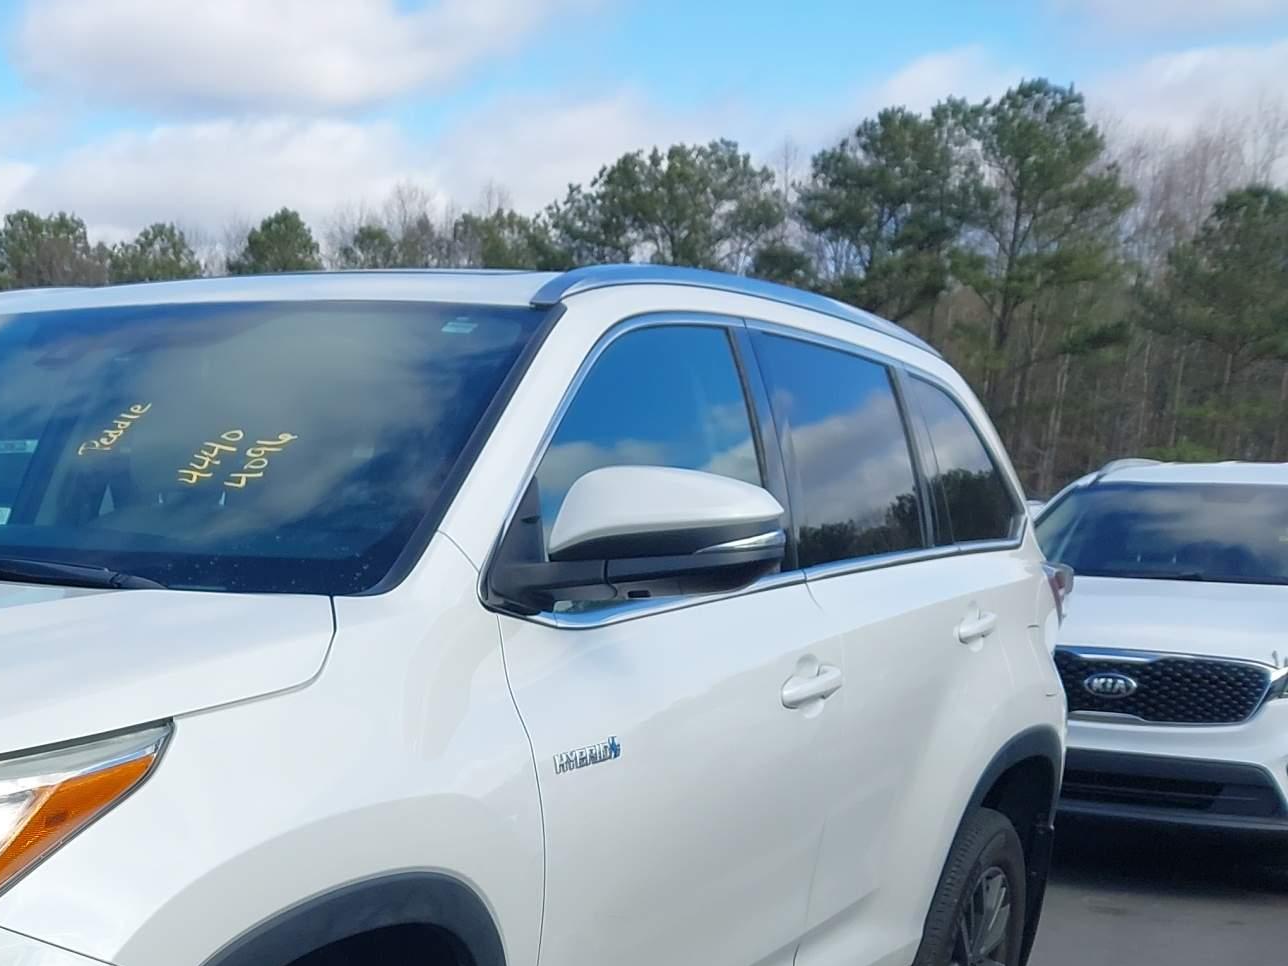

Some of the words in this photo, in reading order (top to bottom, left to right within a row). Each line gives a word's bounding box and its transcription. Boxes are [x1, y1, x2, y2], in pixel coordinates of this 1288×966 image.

[177, 429, 245, 485] 4440
[223, 432, 299, 488] 4096
[1091, 677, 1127, 694] KIA
[552, 742, 613, 775] HYBRID
